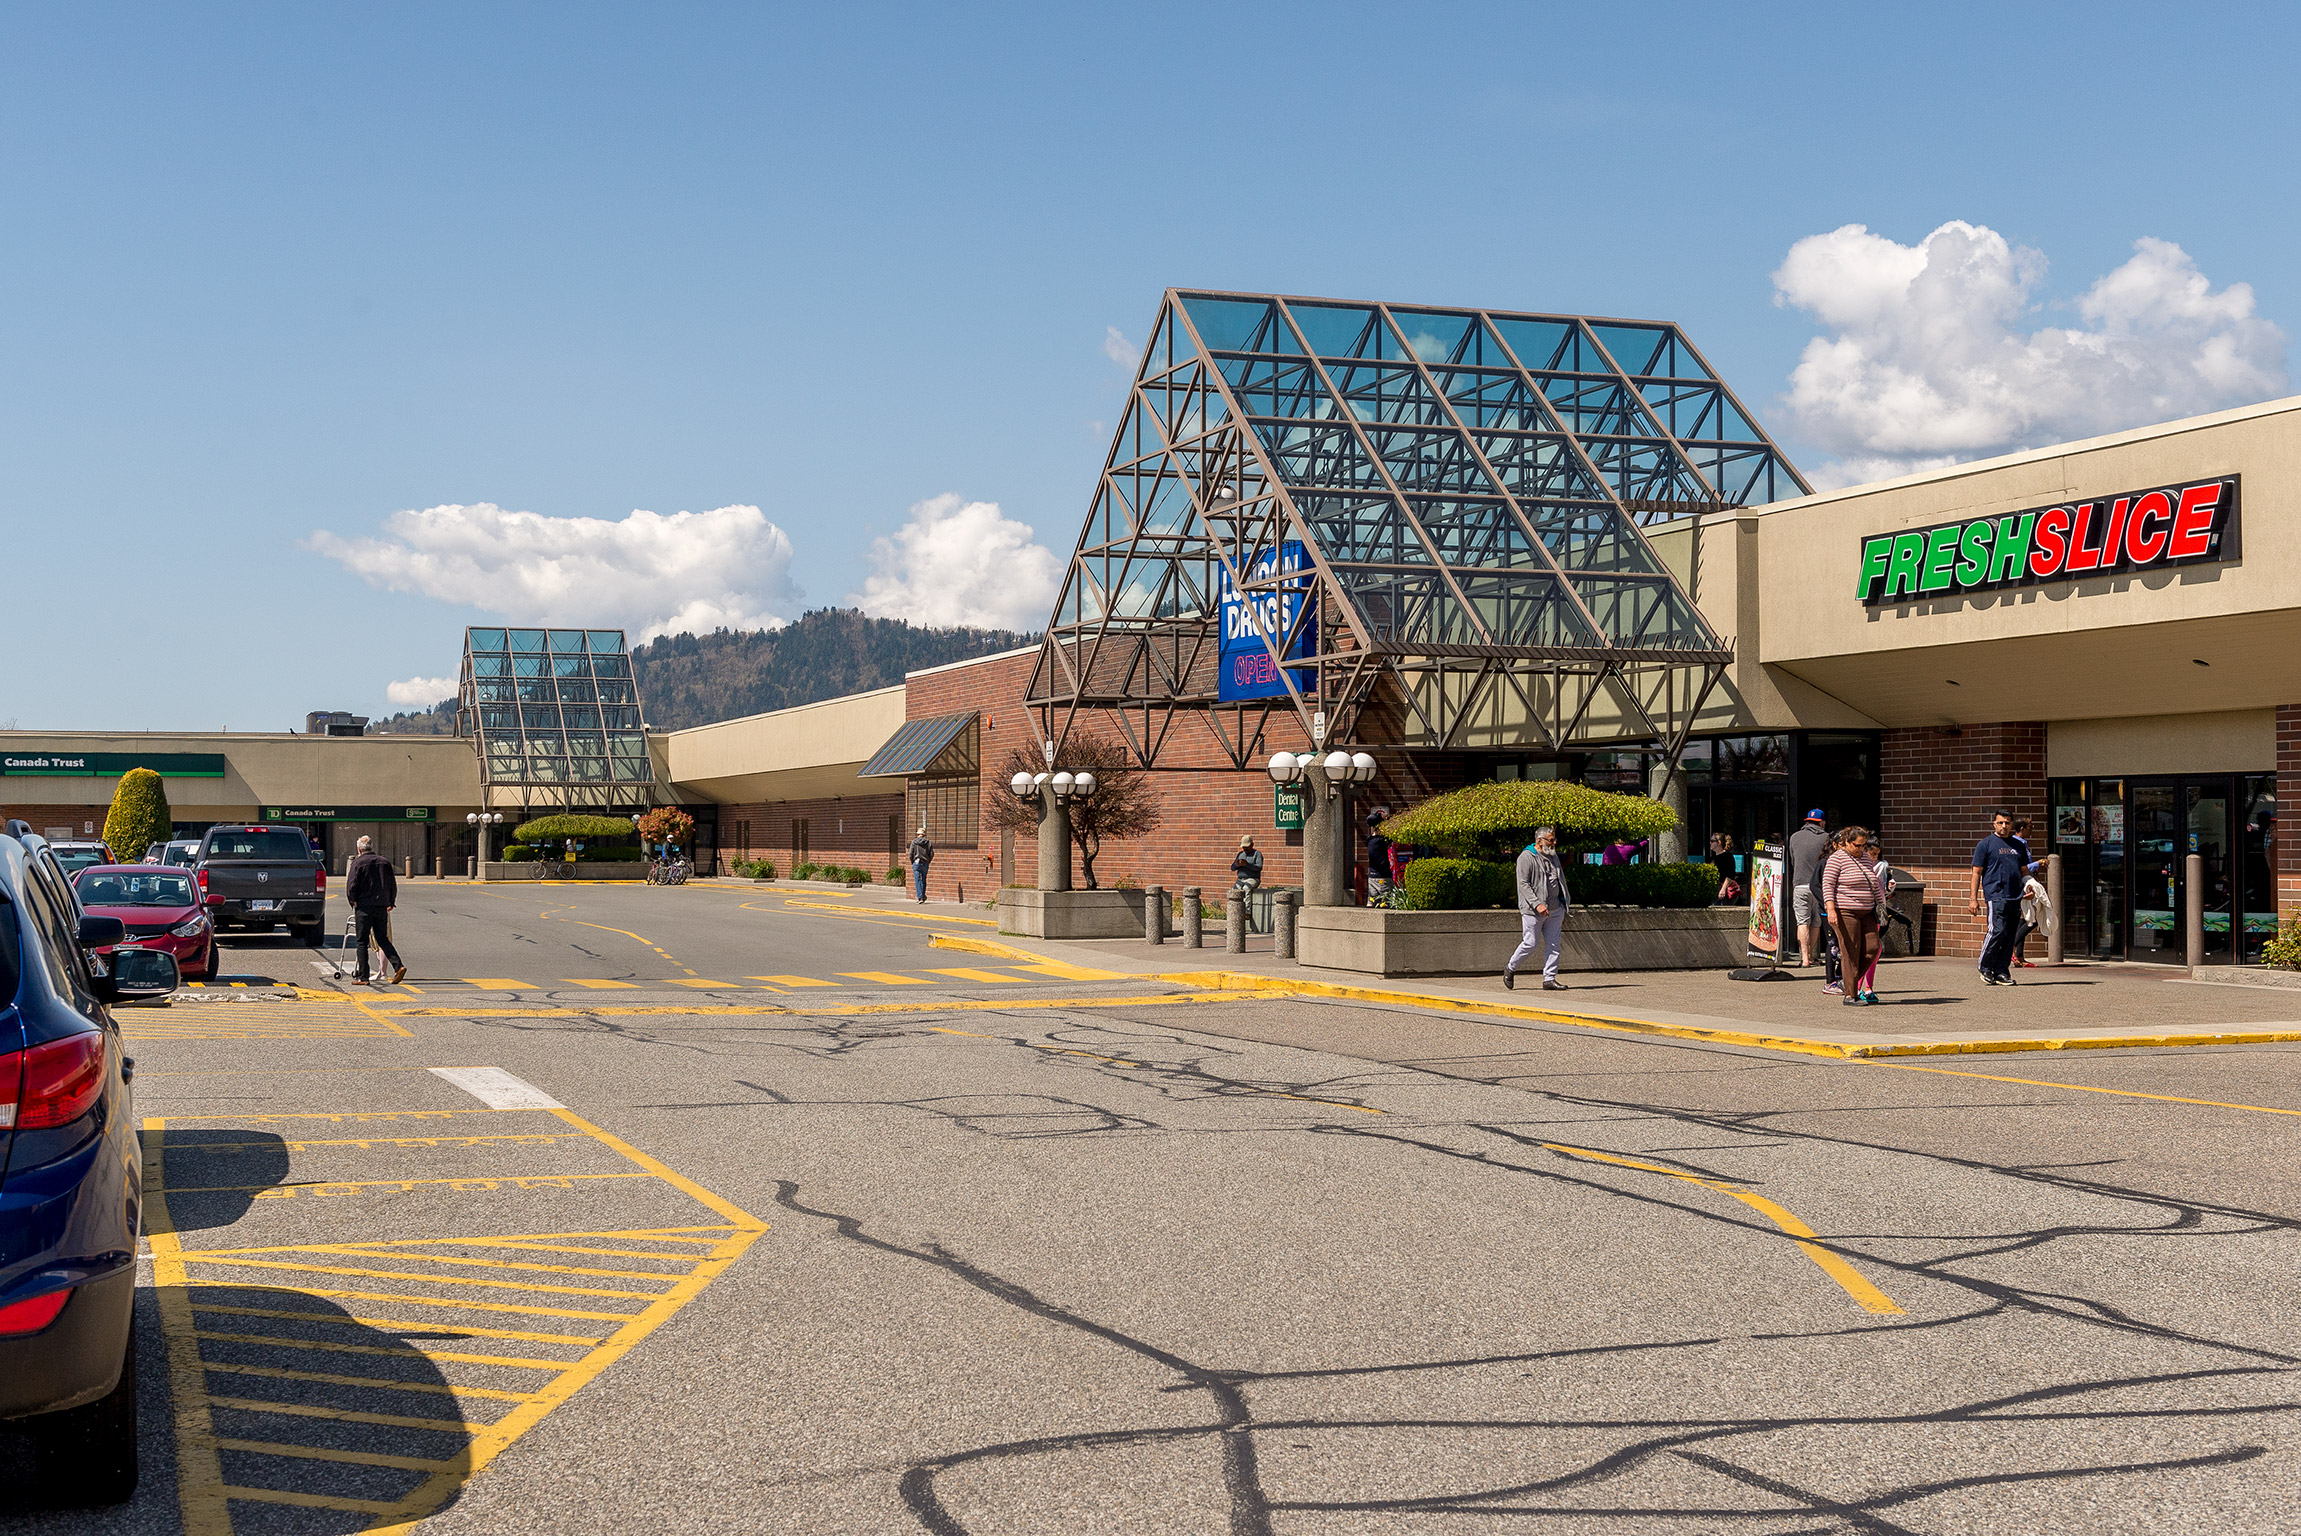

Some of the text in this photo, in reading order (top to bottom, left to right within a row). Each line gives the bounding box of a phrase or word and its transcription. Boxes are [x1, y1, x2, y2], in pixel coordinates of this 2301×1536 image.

[1855, 481, 2223, 601] FRESHSLICE
[1227, 595, 1292, 640] DRUGS
[1234, 653, 1277, 686] OPEN
[4, 758, 85, 767] Canada Trust
[1278, 794, 1299, 806] Dental
[268, 810, 280, 818] TD
[1278, 809, 1299, 822] Centre
[1753, 843, 1783, 853] ANY CLASSIC
[251, 1178, 573, 1199] MOTOR
